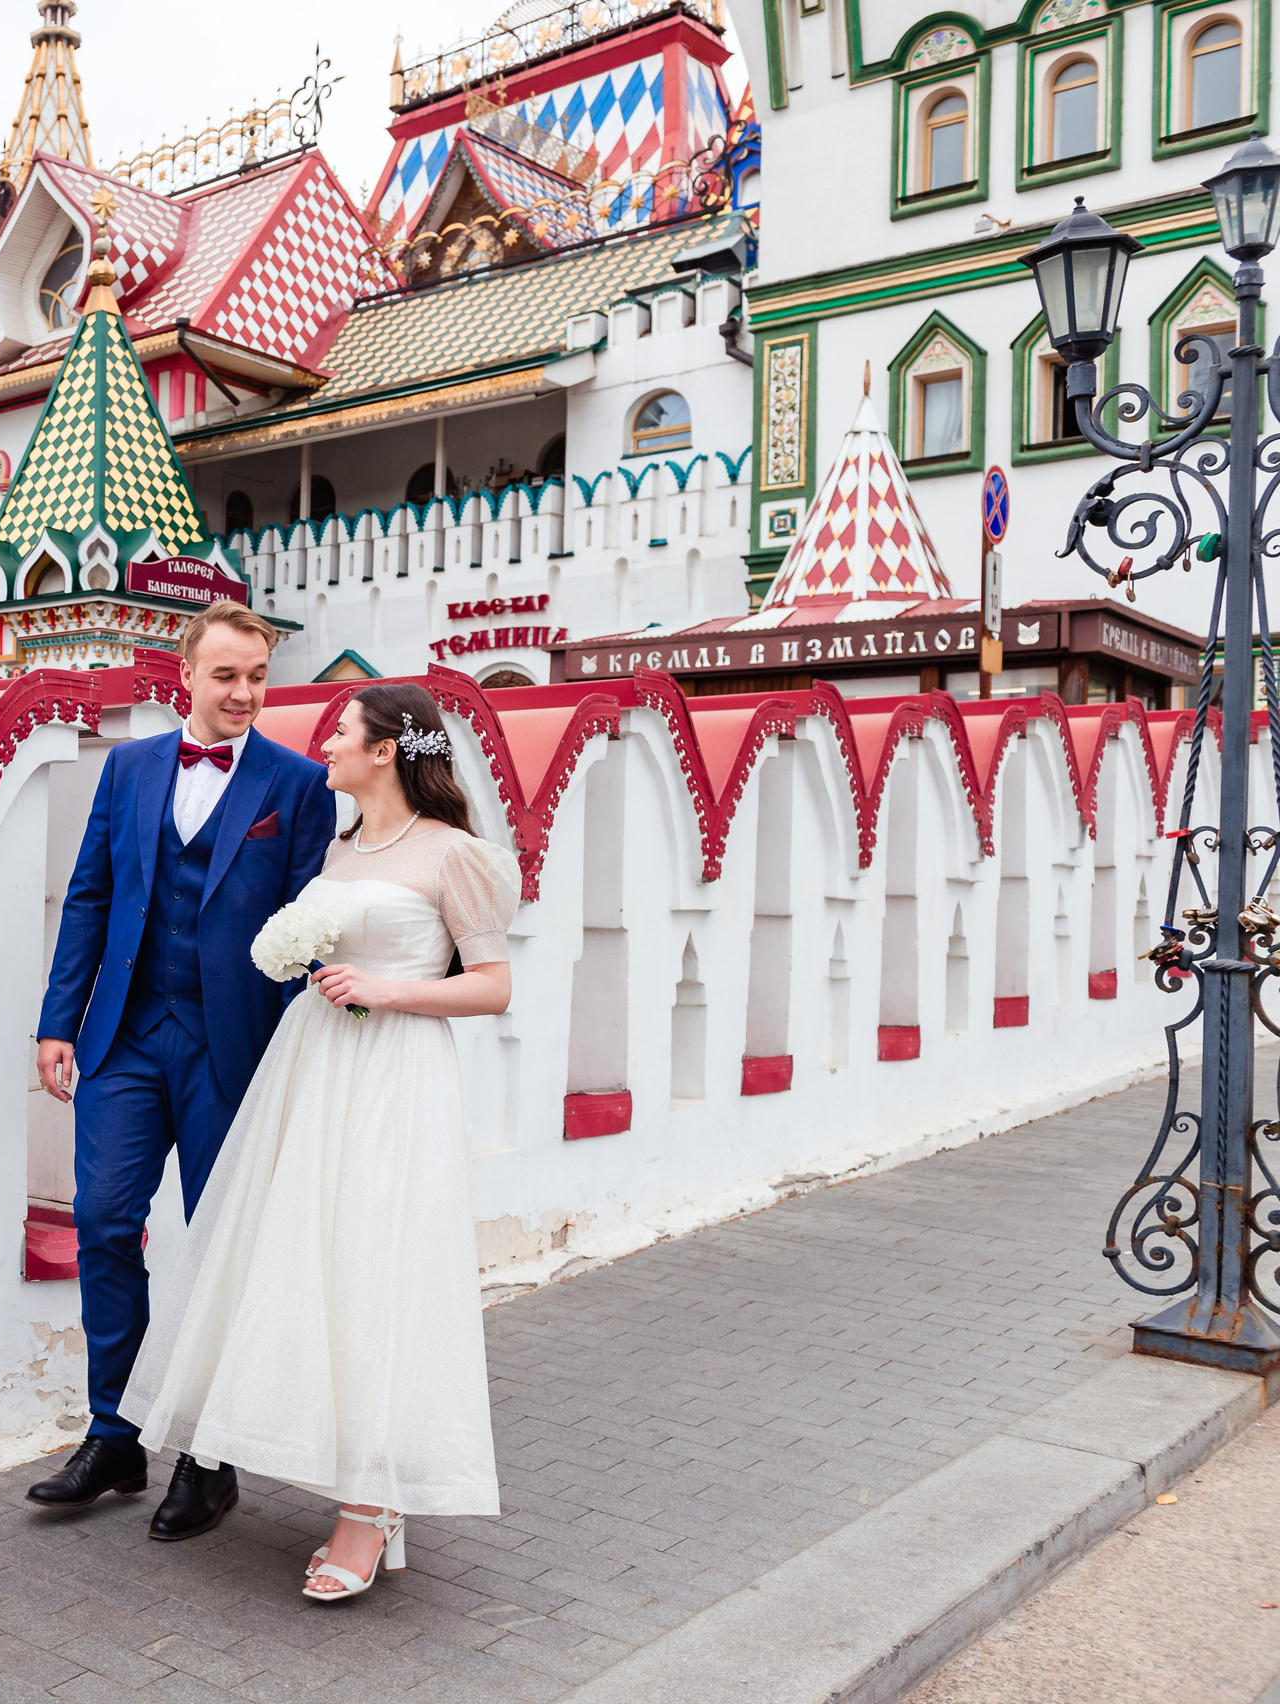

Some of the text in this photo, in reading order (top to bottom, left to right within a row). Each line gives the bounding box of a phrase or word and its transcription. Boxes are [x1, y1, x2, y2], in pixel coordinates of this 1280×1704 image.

[167, 561, 214, 580] ГАЛЕРЕЯ
[147, 580, 211, 602] БАНКЕТНЫЙ
[991, 594, 999, 610] 10
[609, 646, 730, 673] КРЕМЛЬ
[781, 627, 999, 663] ИЗМАЙЛОВ
[1102, 622, 1139, 657] КРЕМЛЬ
